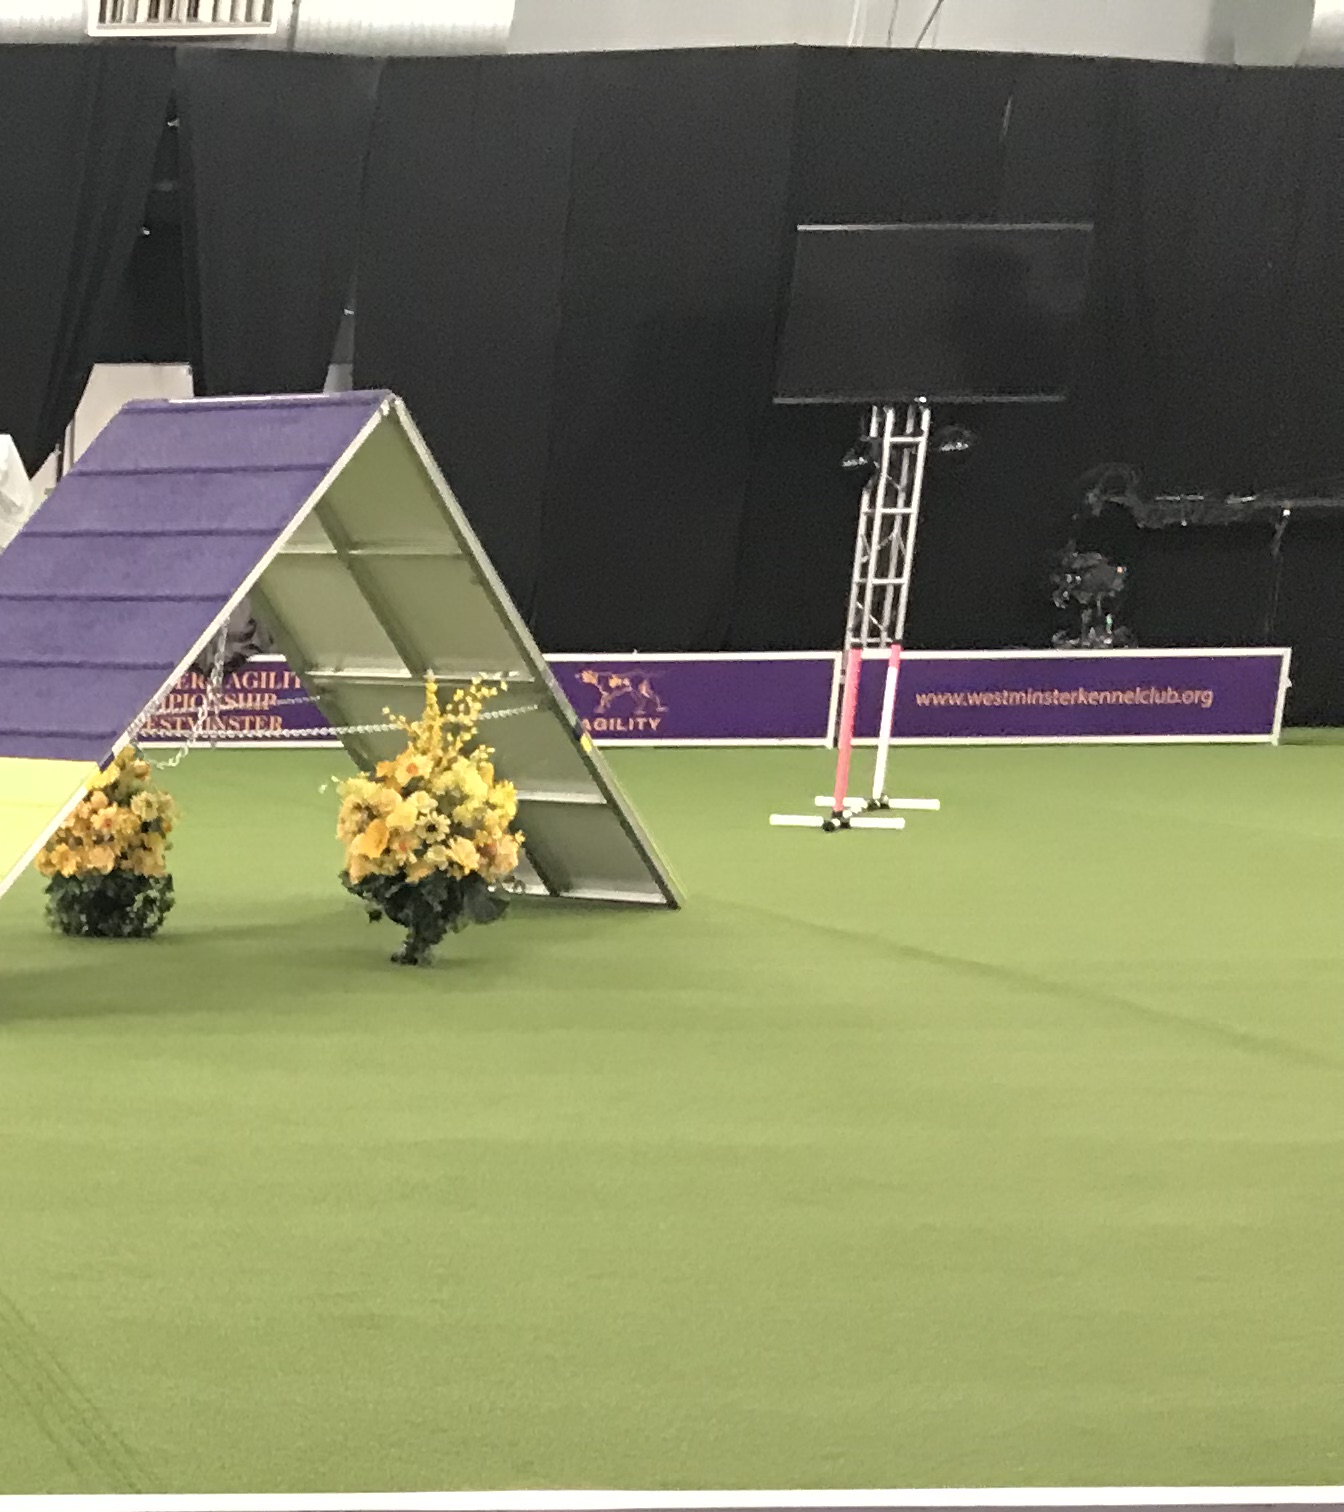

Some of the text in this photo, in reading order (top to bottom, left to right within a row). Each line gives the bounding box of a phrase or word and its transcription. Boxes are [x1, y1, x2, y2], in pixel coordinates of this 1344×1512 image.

[227, 671, 302, 689] AGILIT
[915, 687, 1213, 708] www.westminsterkennelclub.org
[581, 717, 661, 731] AGILITY
